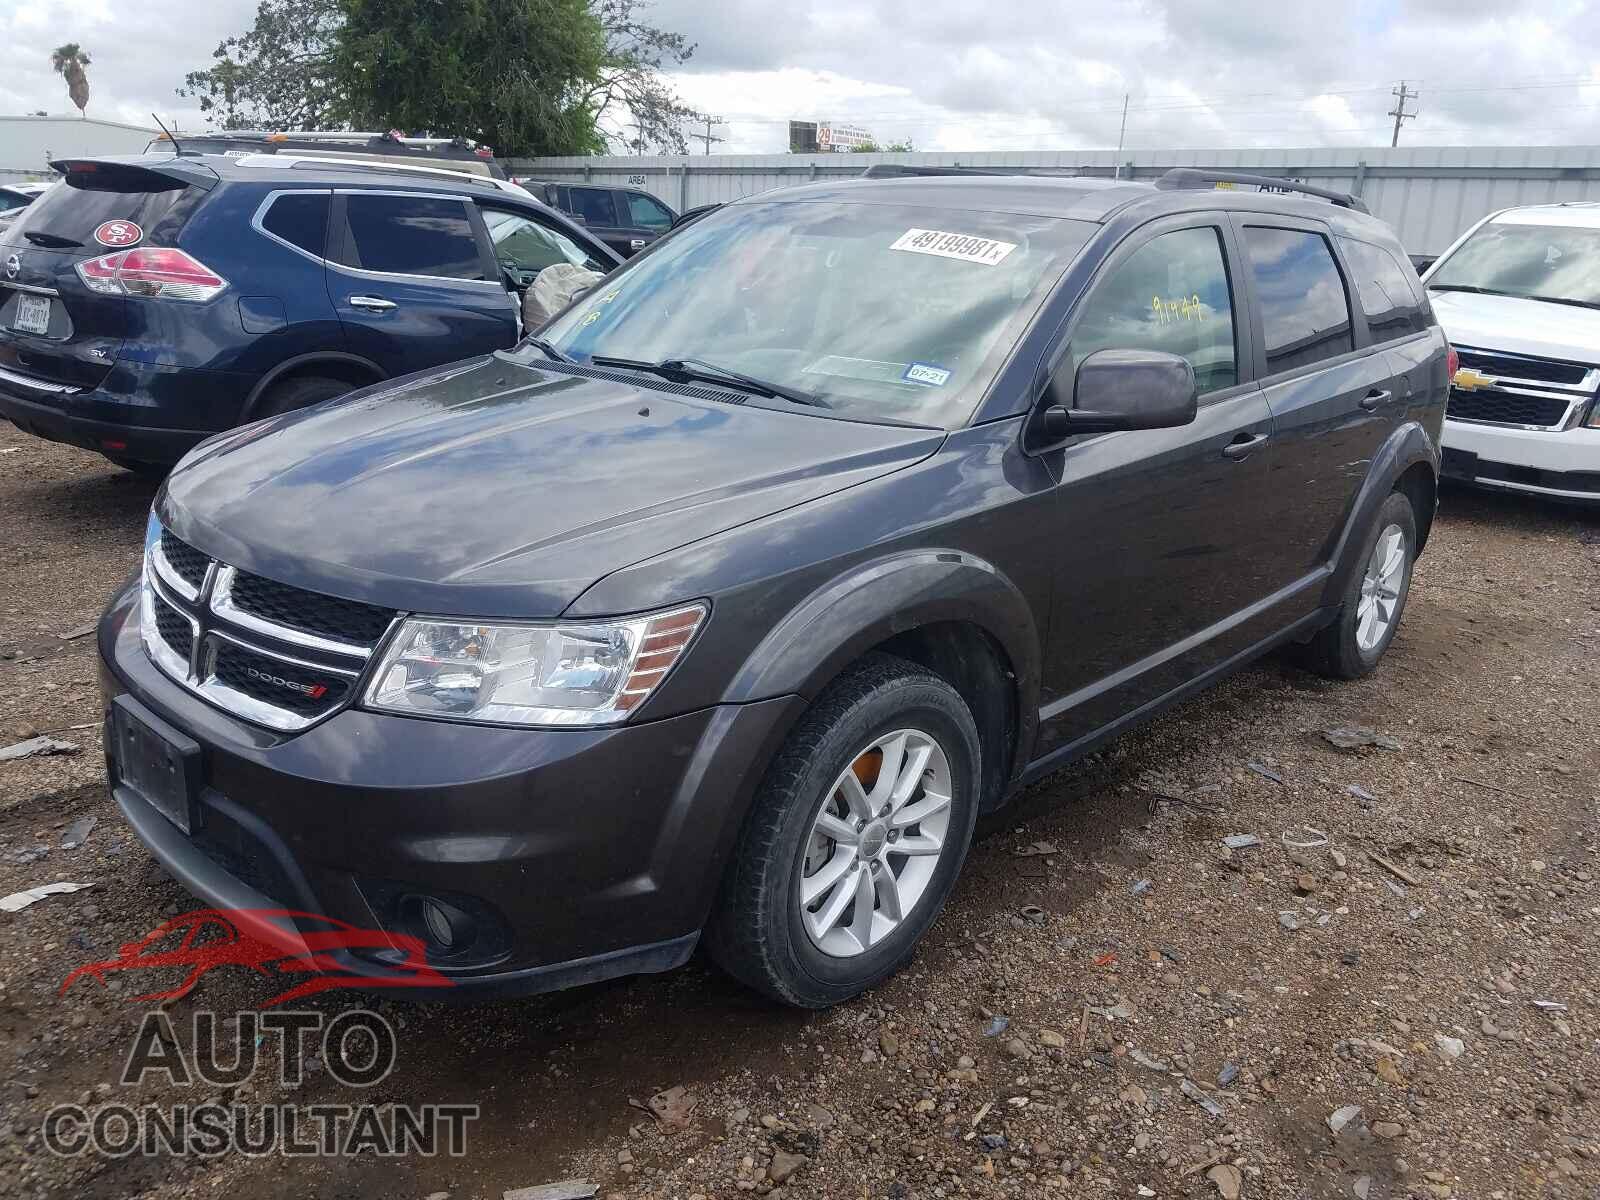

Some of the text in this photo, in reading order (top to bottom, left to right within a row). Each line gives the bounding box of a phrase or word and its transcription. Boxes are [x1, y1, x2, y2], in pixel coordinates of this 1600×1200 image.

[628, 175, 646, 185] AREA
[911, 231, 998, 258] 49199981
[90, 349, 106, 358] SV
[247, 667, 313, 694] DODGE
